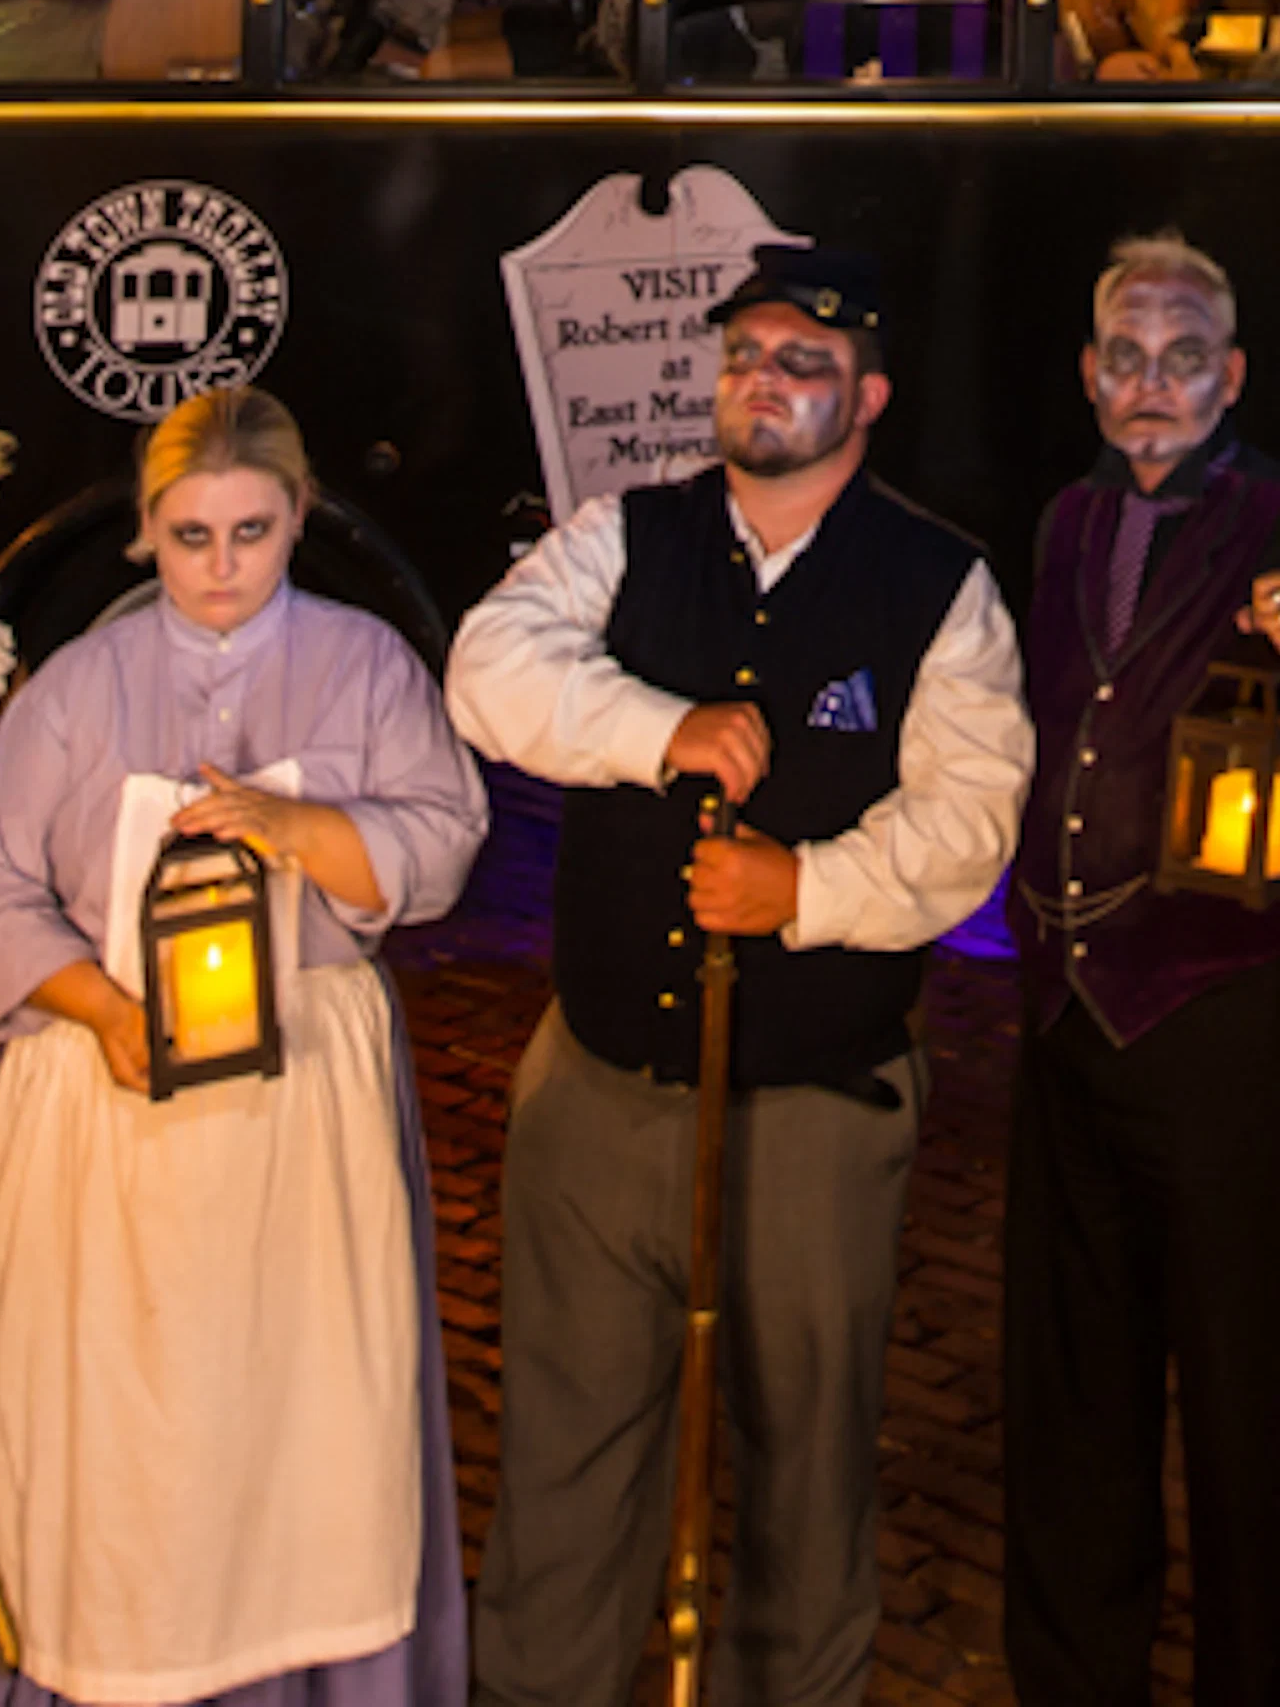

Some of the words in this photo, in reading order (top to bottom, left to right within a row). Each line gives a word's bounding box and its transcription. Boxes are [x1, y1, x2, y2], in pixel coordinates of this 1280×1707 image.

[64, 189, 167, 261] TOWN
[177, 189, 279, 324] TROLLEY
[42, 261, 89, 325] OLD
[621, 264, 724, 303] VISIT
[557, 310, 668, 349] Robert
[69, 338, 248, 414] TOURS
[660, 356, 692, 381] at
[568, 396, 637, 428] East
